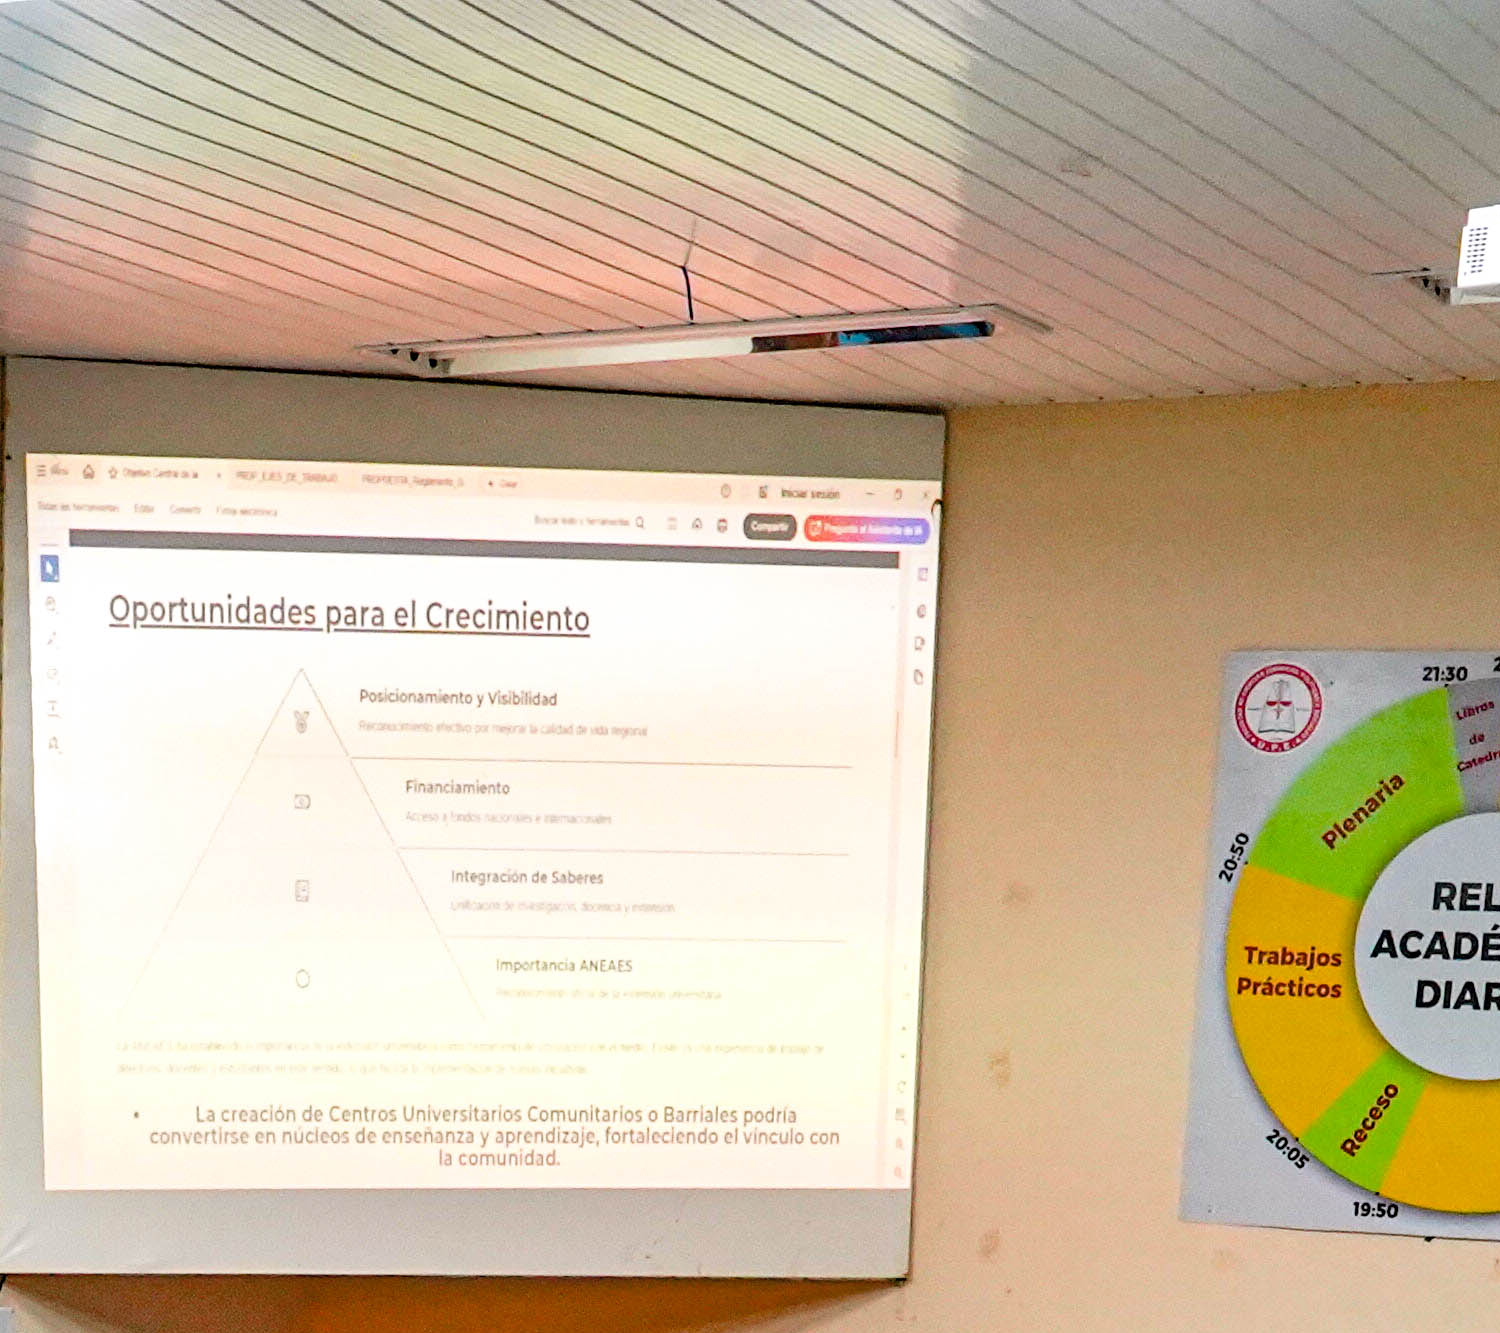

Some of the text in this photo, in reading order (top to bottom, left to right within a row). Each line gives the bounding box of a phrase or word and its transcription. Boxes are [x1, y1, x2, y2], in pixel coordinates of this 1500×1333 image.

[109, 594, 590, 636] Oportunidades para el Crecimiento
[1422, 666, 1468, 682] 21:30
[360, 688, 557, 708] Posicionamiento y Visibilidad
[1469, 733, 1485, 745] de
[406, 780, 510, 795] Financiamiento
[1320, 771, 1406, 850] Plenaria
[1218, 832, 1250, 883] 20:50
[452, 869, 603, 886] Integración de Saberes
[497, 960, 632, 973] Importancia ANEAES
[1243, 945, 1343, 970] Trabajos
[1236, 975, 1343, 1000] Prácticos
[196, 1104, 797, 1127] La creación de Centros Universitarios Comunitarios o Barriales podría
[1340, 1083, 1399, 1158] Receso
[150, 1126, 839, 1149] convertirse en núcleos de enseñanza y aprendizaje, fortaleciendo el vínculo con
[439, 1147, 560, 1166] la comunidad.
[1265, 1128, 1311, 1171] 20:05
[1351, 1200, 1400, 1221] 19:50
